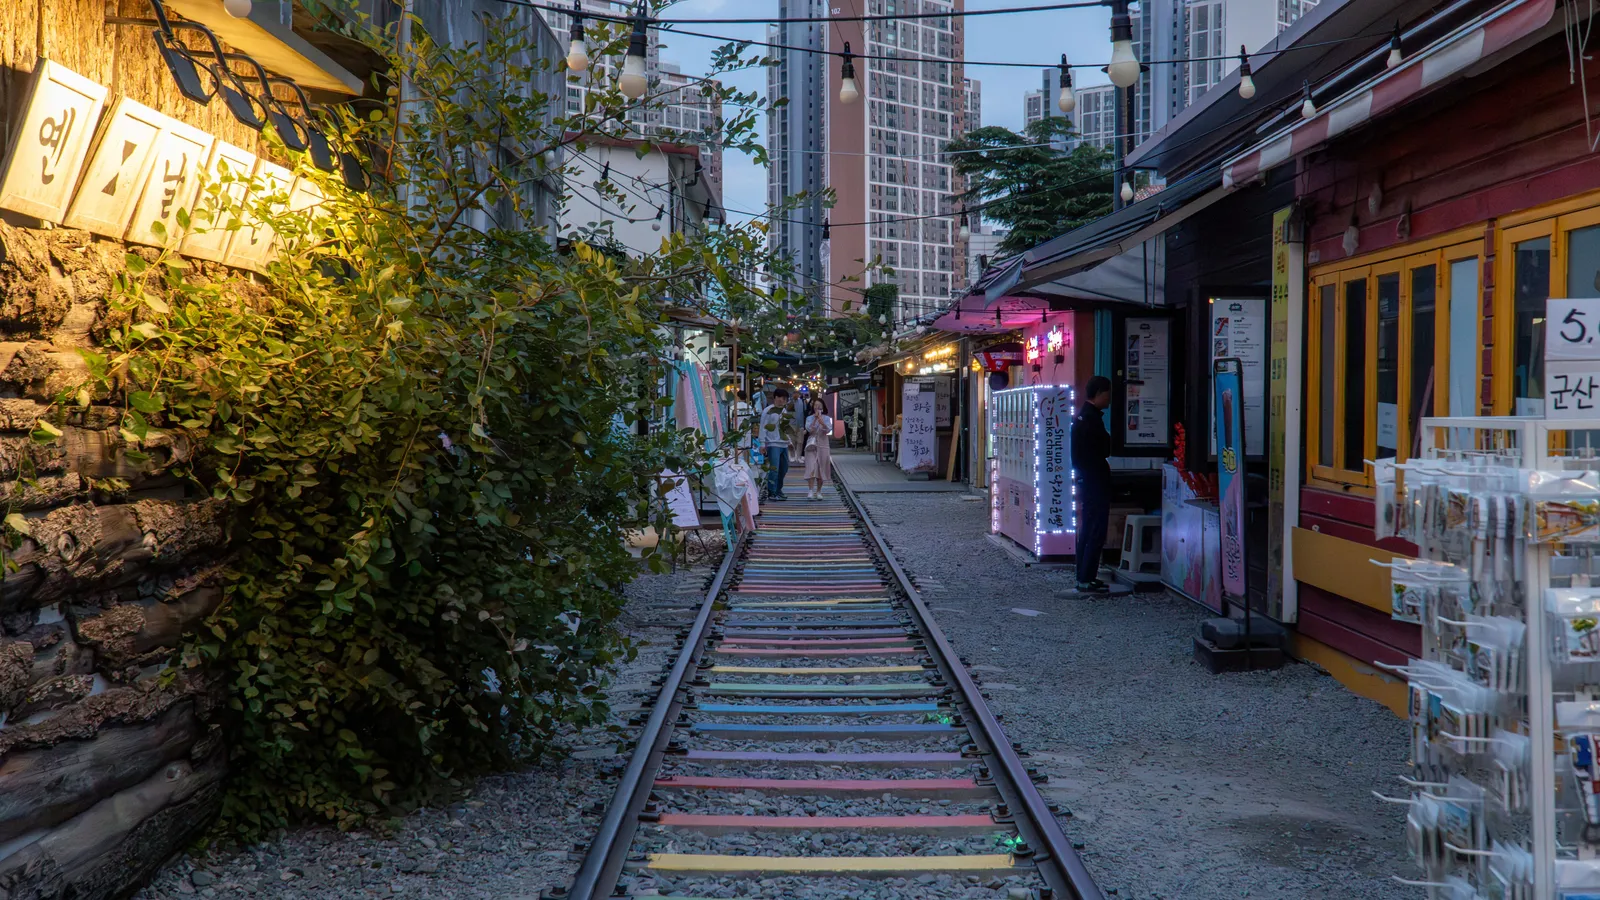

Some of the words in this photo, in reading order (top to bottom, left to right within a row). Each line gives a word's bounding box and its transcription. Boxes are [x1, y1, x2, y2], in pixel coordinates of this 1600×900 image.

[1560, 308, 1600, 343] 5,
[1550, 375, 1600, 410] 군산
[908, 423, 934, 435] 오란다
[1045, 417, 1055, 437] take
[911, 445, 930, 457] 유과
[1045, 439, 1055, 473] chance
[1048, 474, 1064, 505] 닥치고
